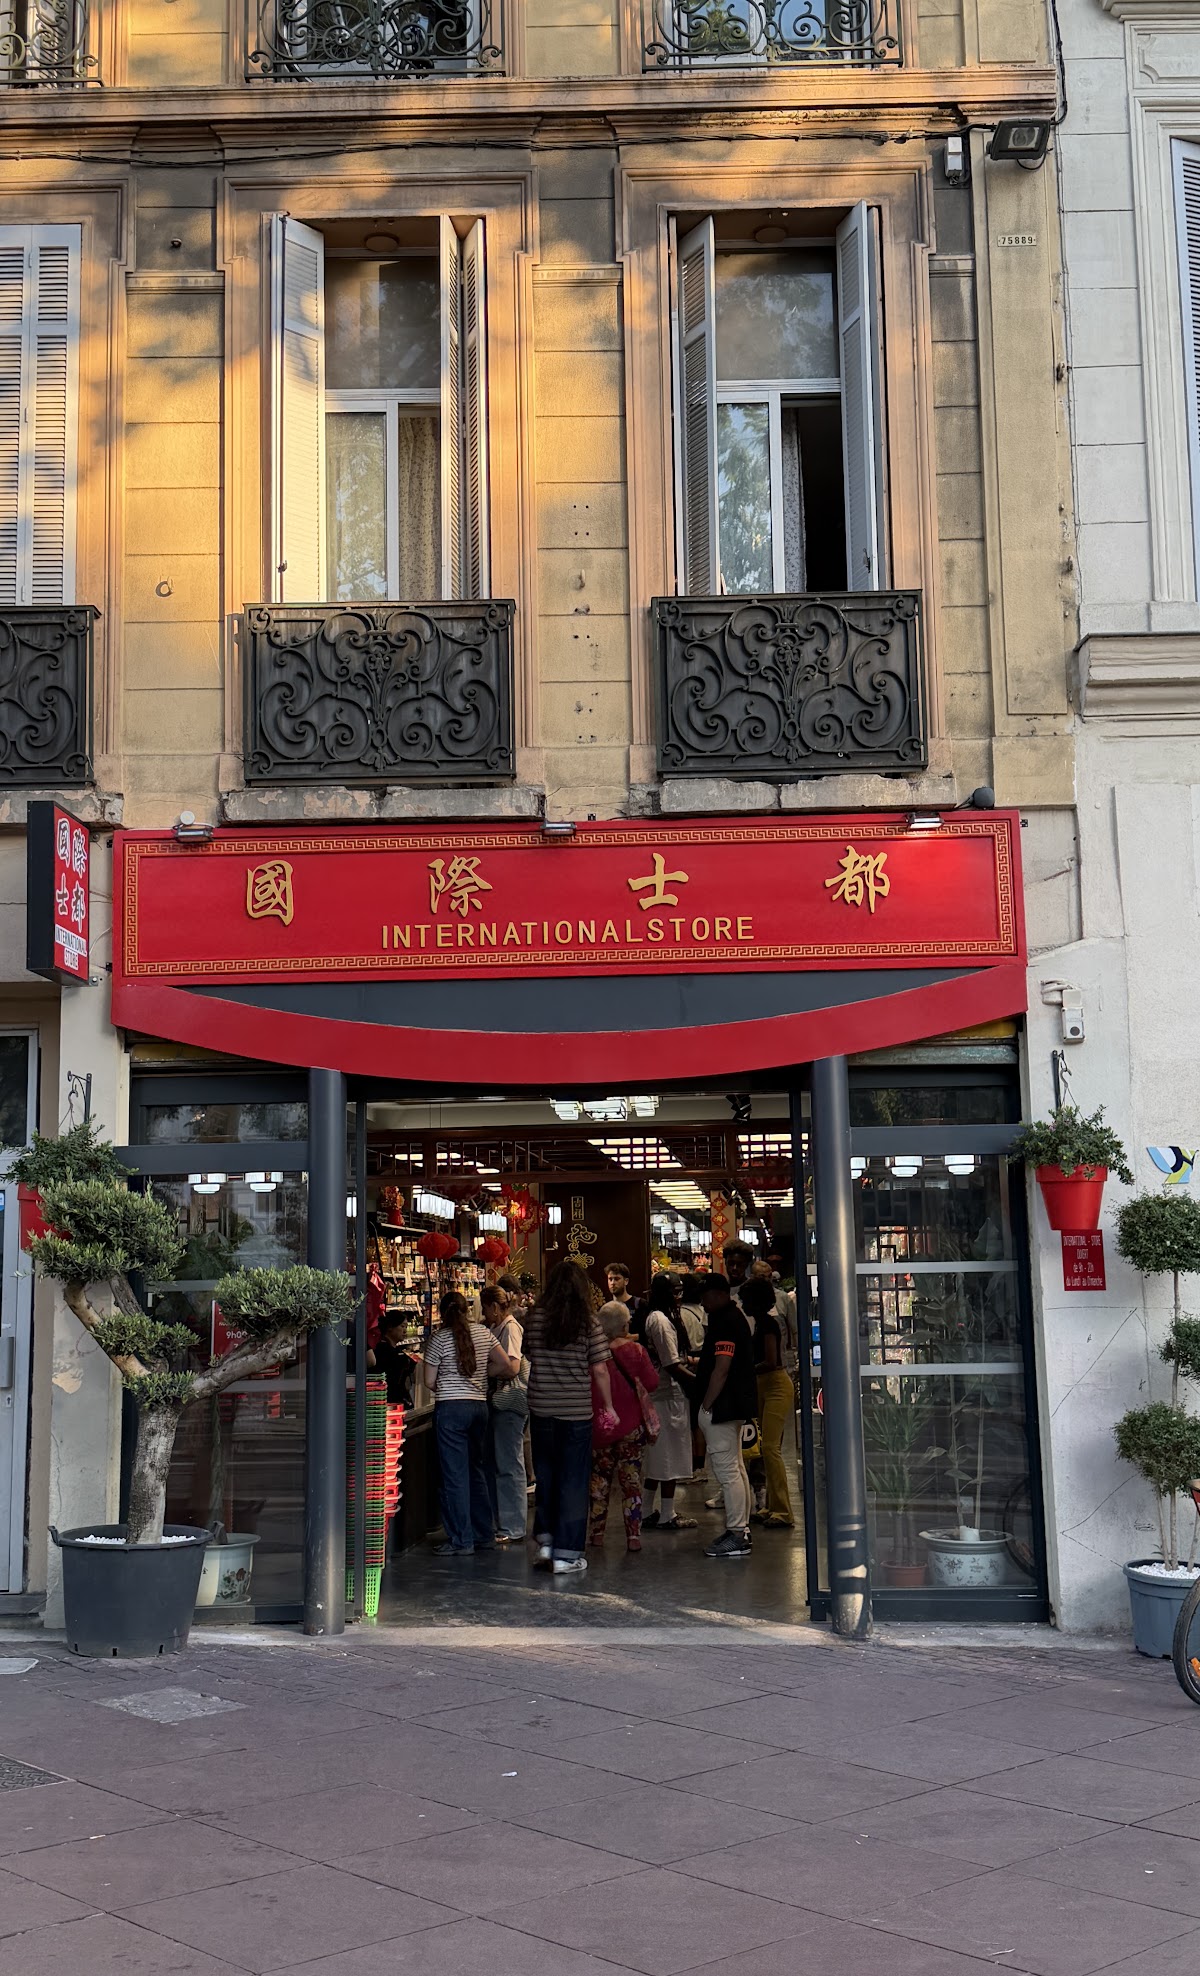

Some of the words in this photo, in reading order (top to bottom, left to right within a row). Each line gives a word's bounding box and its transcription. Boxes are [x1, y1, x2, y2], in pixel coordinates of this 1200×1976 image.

[1001, 236, 1033, 245] 75889
[55, 924, 88, 957] INTERNATIONAL
[64, 947, 79, 970] STORE
[1063, 1235, 1087, 1246] INTERNATIONAL
[1091, 1235, 1101, 1246] STORE
[1076, 1248, 1089, 1259] OUVERT
